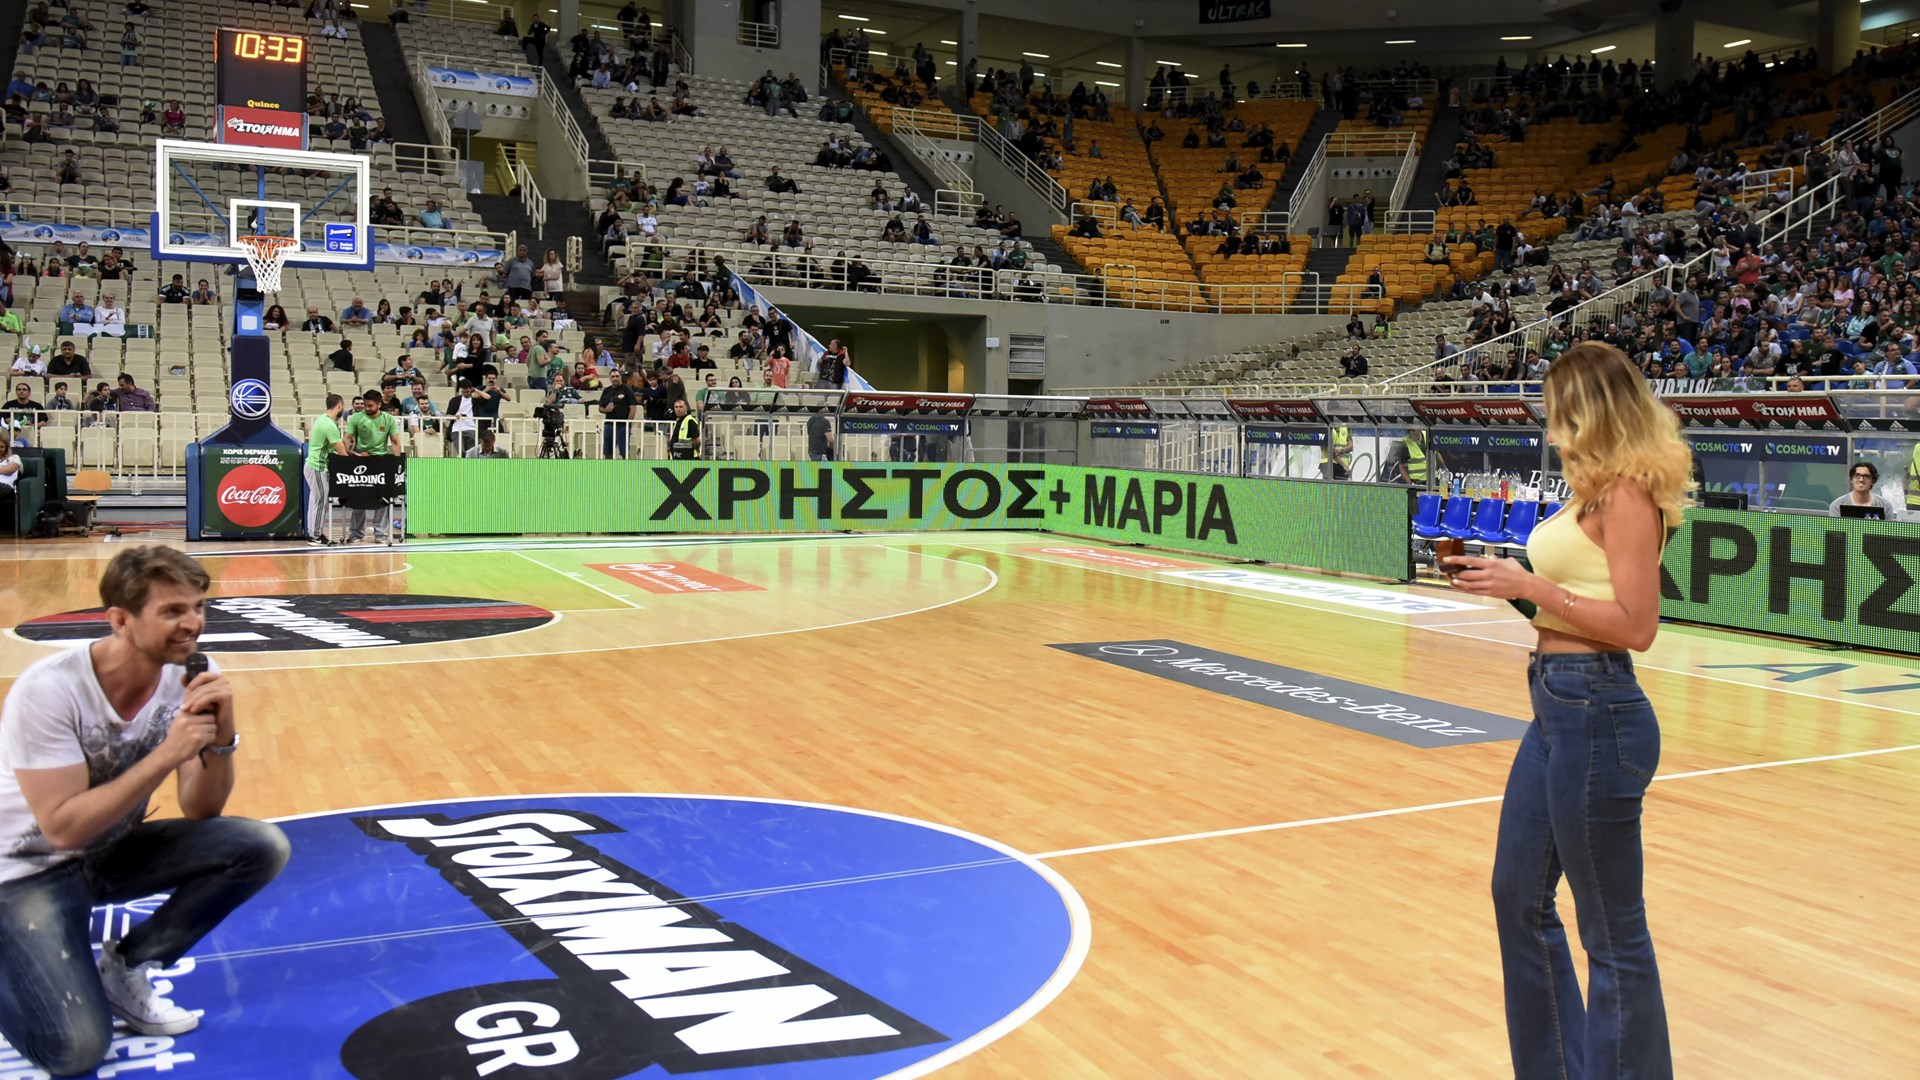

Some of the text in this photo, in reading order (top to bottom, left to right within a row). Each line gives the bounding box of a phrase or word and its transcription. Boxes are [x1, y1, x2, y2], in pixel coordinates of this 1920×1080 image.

[1208, 2, 1265, 20] ULTRAS
[235, 33, 303, 63] 10:33
[247, 100, 280, 109] Quince
[336, 473, 386, 485] SPALDING
[649, 467, 1045, 521] ΧΡΗΣΤΟΣ
[1084, 474, 1238, 544] ΜΑΡΙΑ
[1153, 656, 1487, 737] Mercedes-Benz
[454, 1001, 580, 1077] GR
